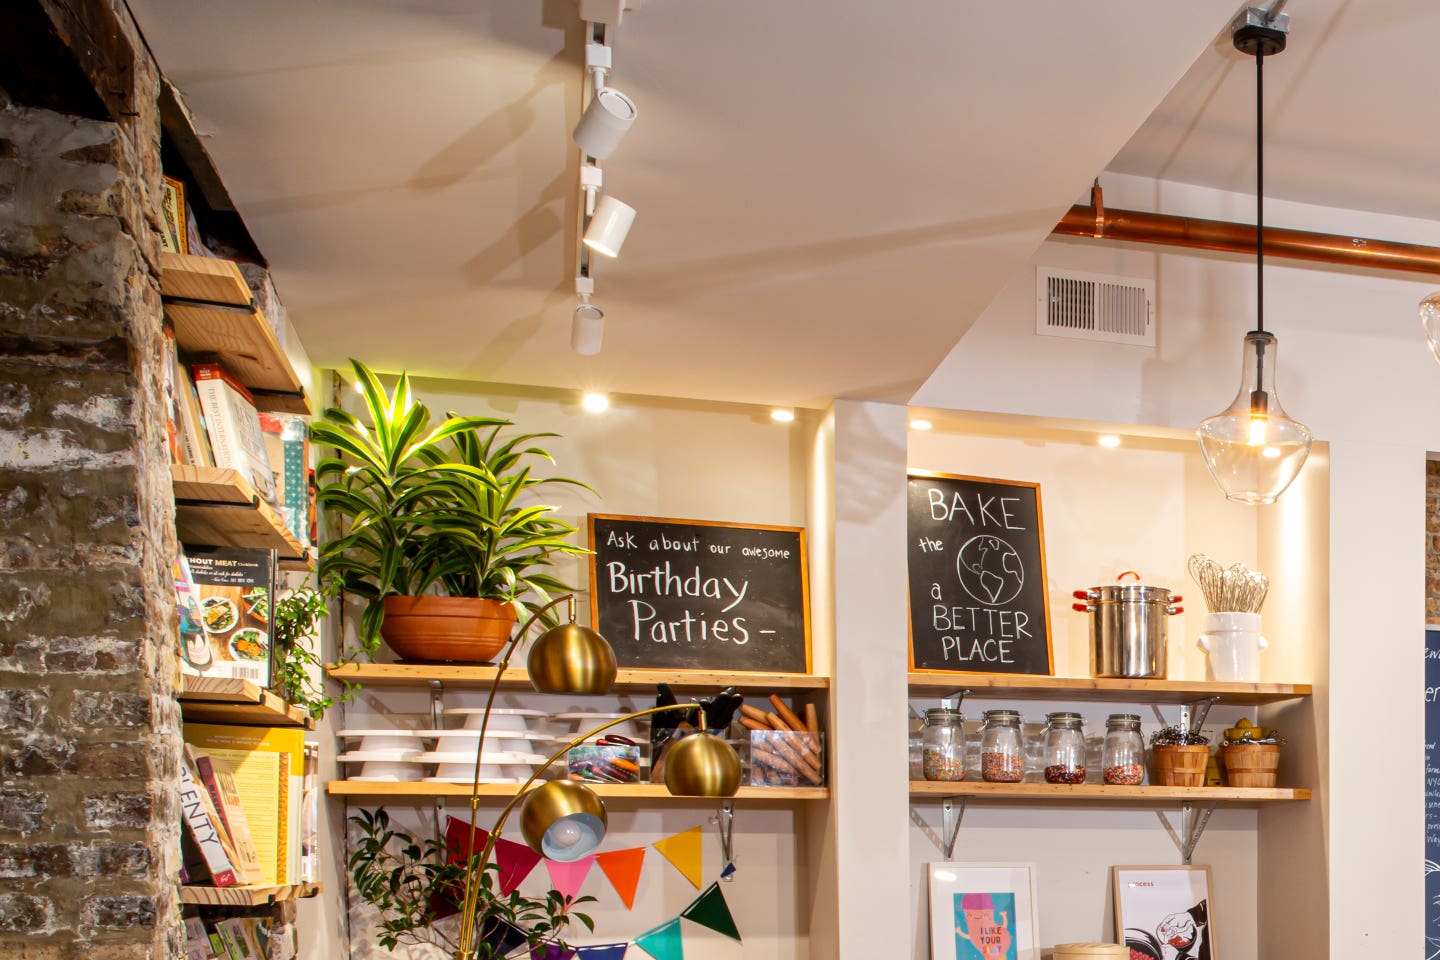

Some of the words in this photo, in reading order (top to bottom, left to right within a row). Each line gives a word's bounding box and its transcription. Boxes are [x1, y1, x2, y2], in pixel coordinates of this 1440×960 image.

[927, 488, 1026, 530] BAKE
[606, 530, 638, 549] Ask
[649, 533, 700, 552] about
[709, 543, 731, 555] our
[742, 546, 790, 559] awesome
[918, 536, 944, 553] the
[606, 561, 749, 613] Birthday
[930, 583, 942, 601] a
[933, 604, 1033, 640] BETTER
[941, 635, 1015, 664] PLACE
[980, 936, 1001, 945] YOUR
[984, 926, 1002, 935] LIKE
